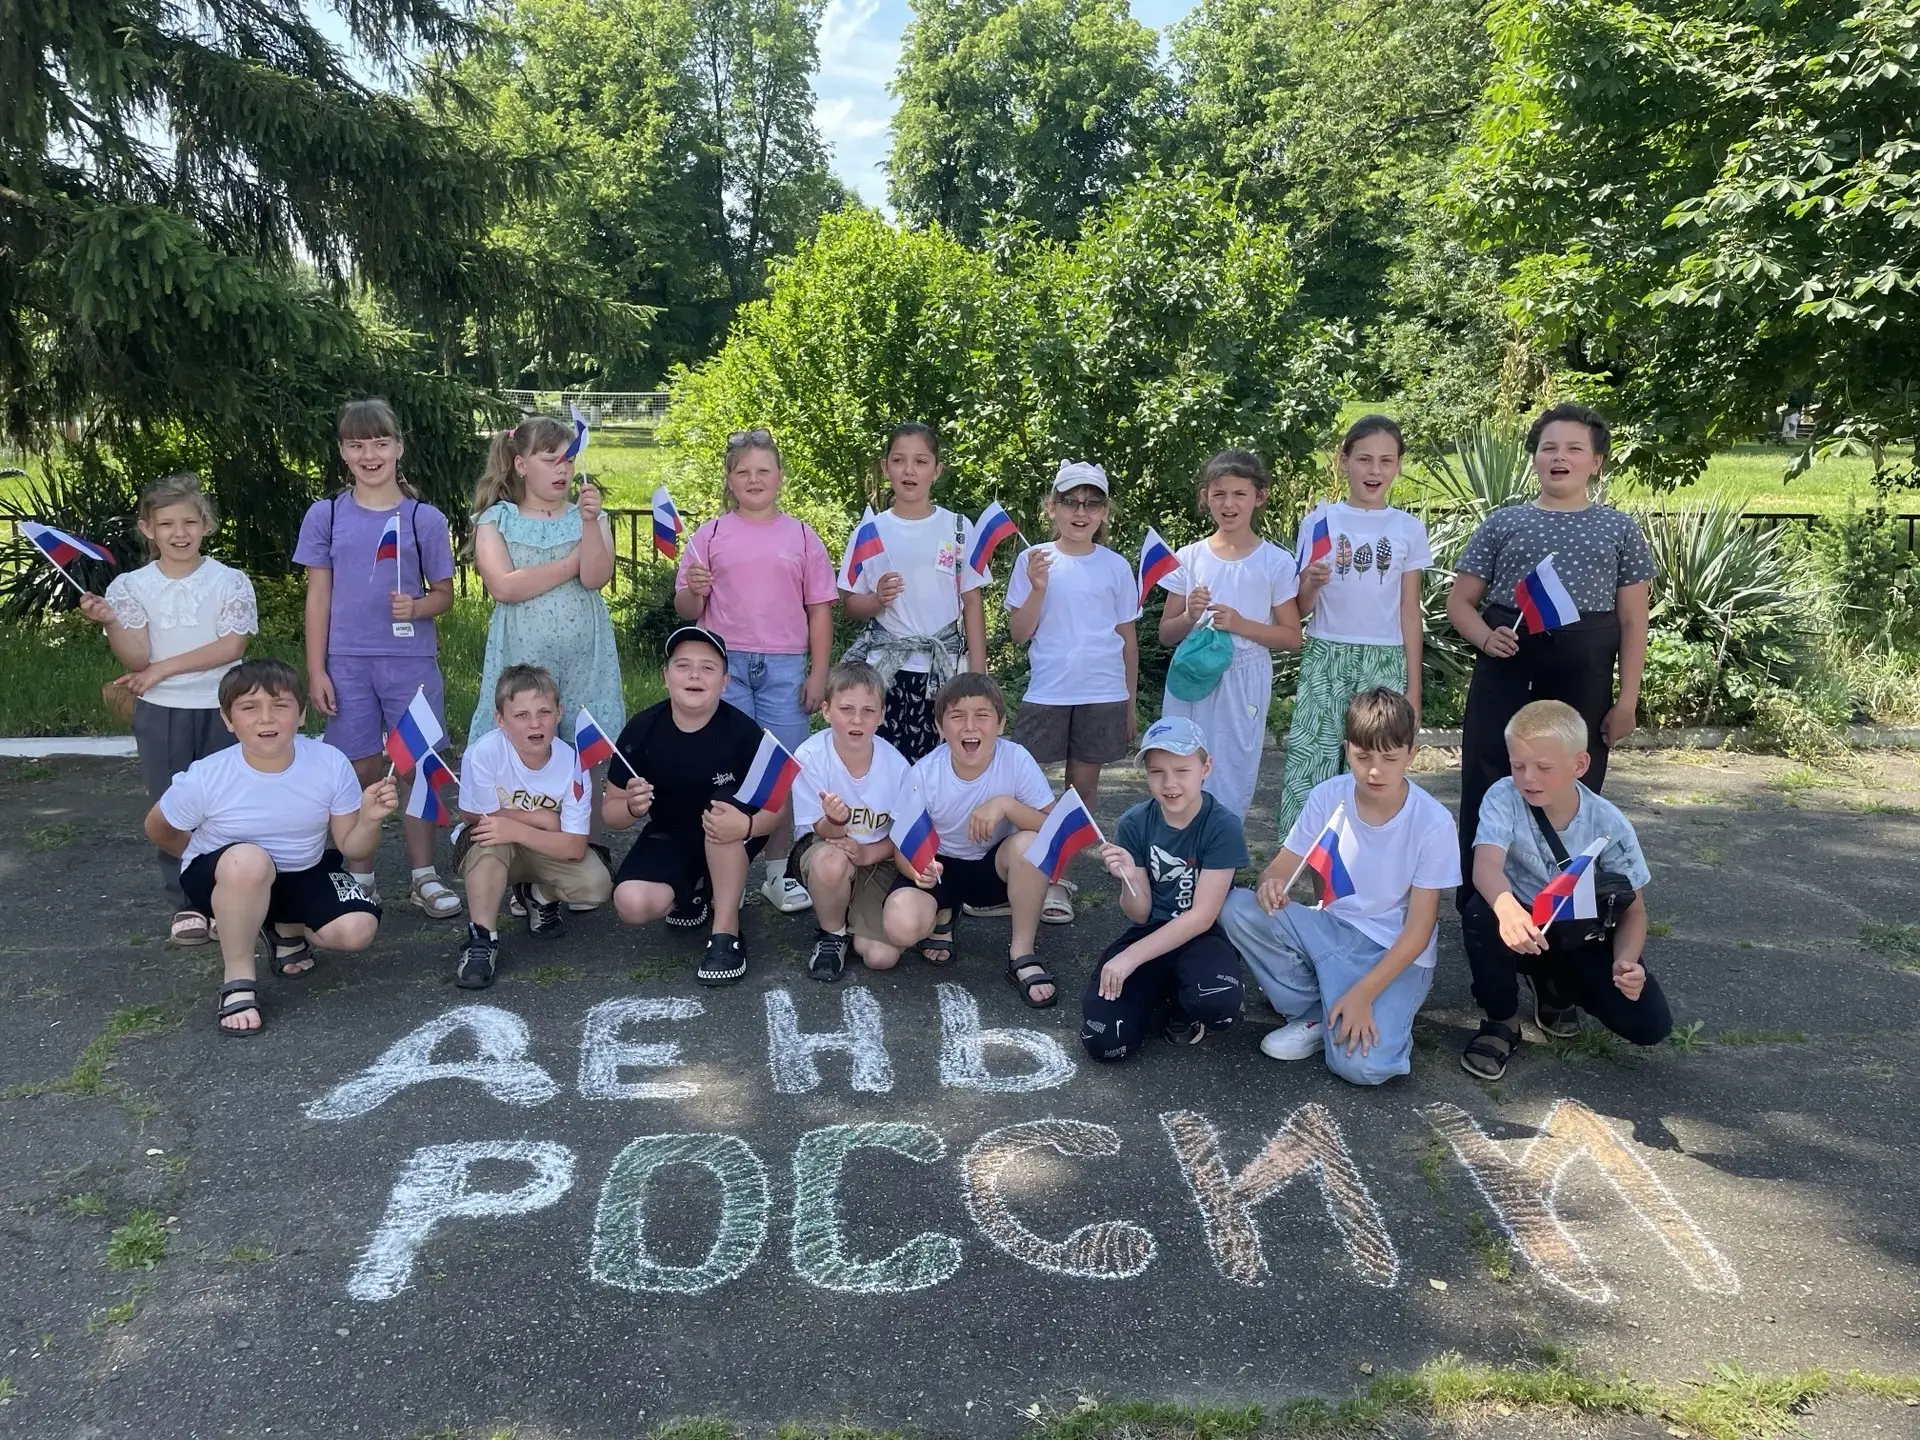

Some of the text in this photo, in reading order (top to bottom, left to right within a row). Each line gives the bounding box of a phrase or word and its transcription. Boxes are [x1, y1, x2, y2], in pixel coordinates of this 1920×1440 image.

[850, 807, 892, 829] END
[303, 982, 1078, 1122] ДЕНЬ
[346, 1098, 1741, 1303] РОССИИ
